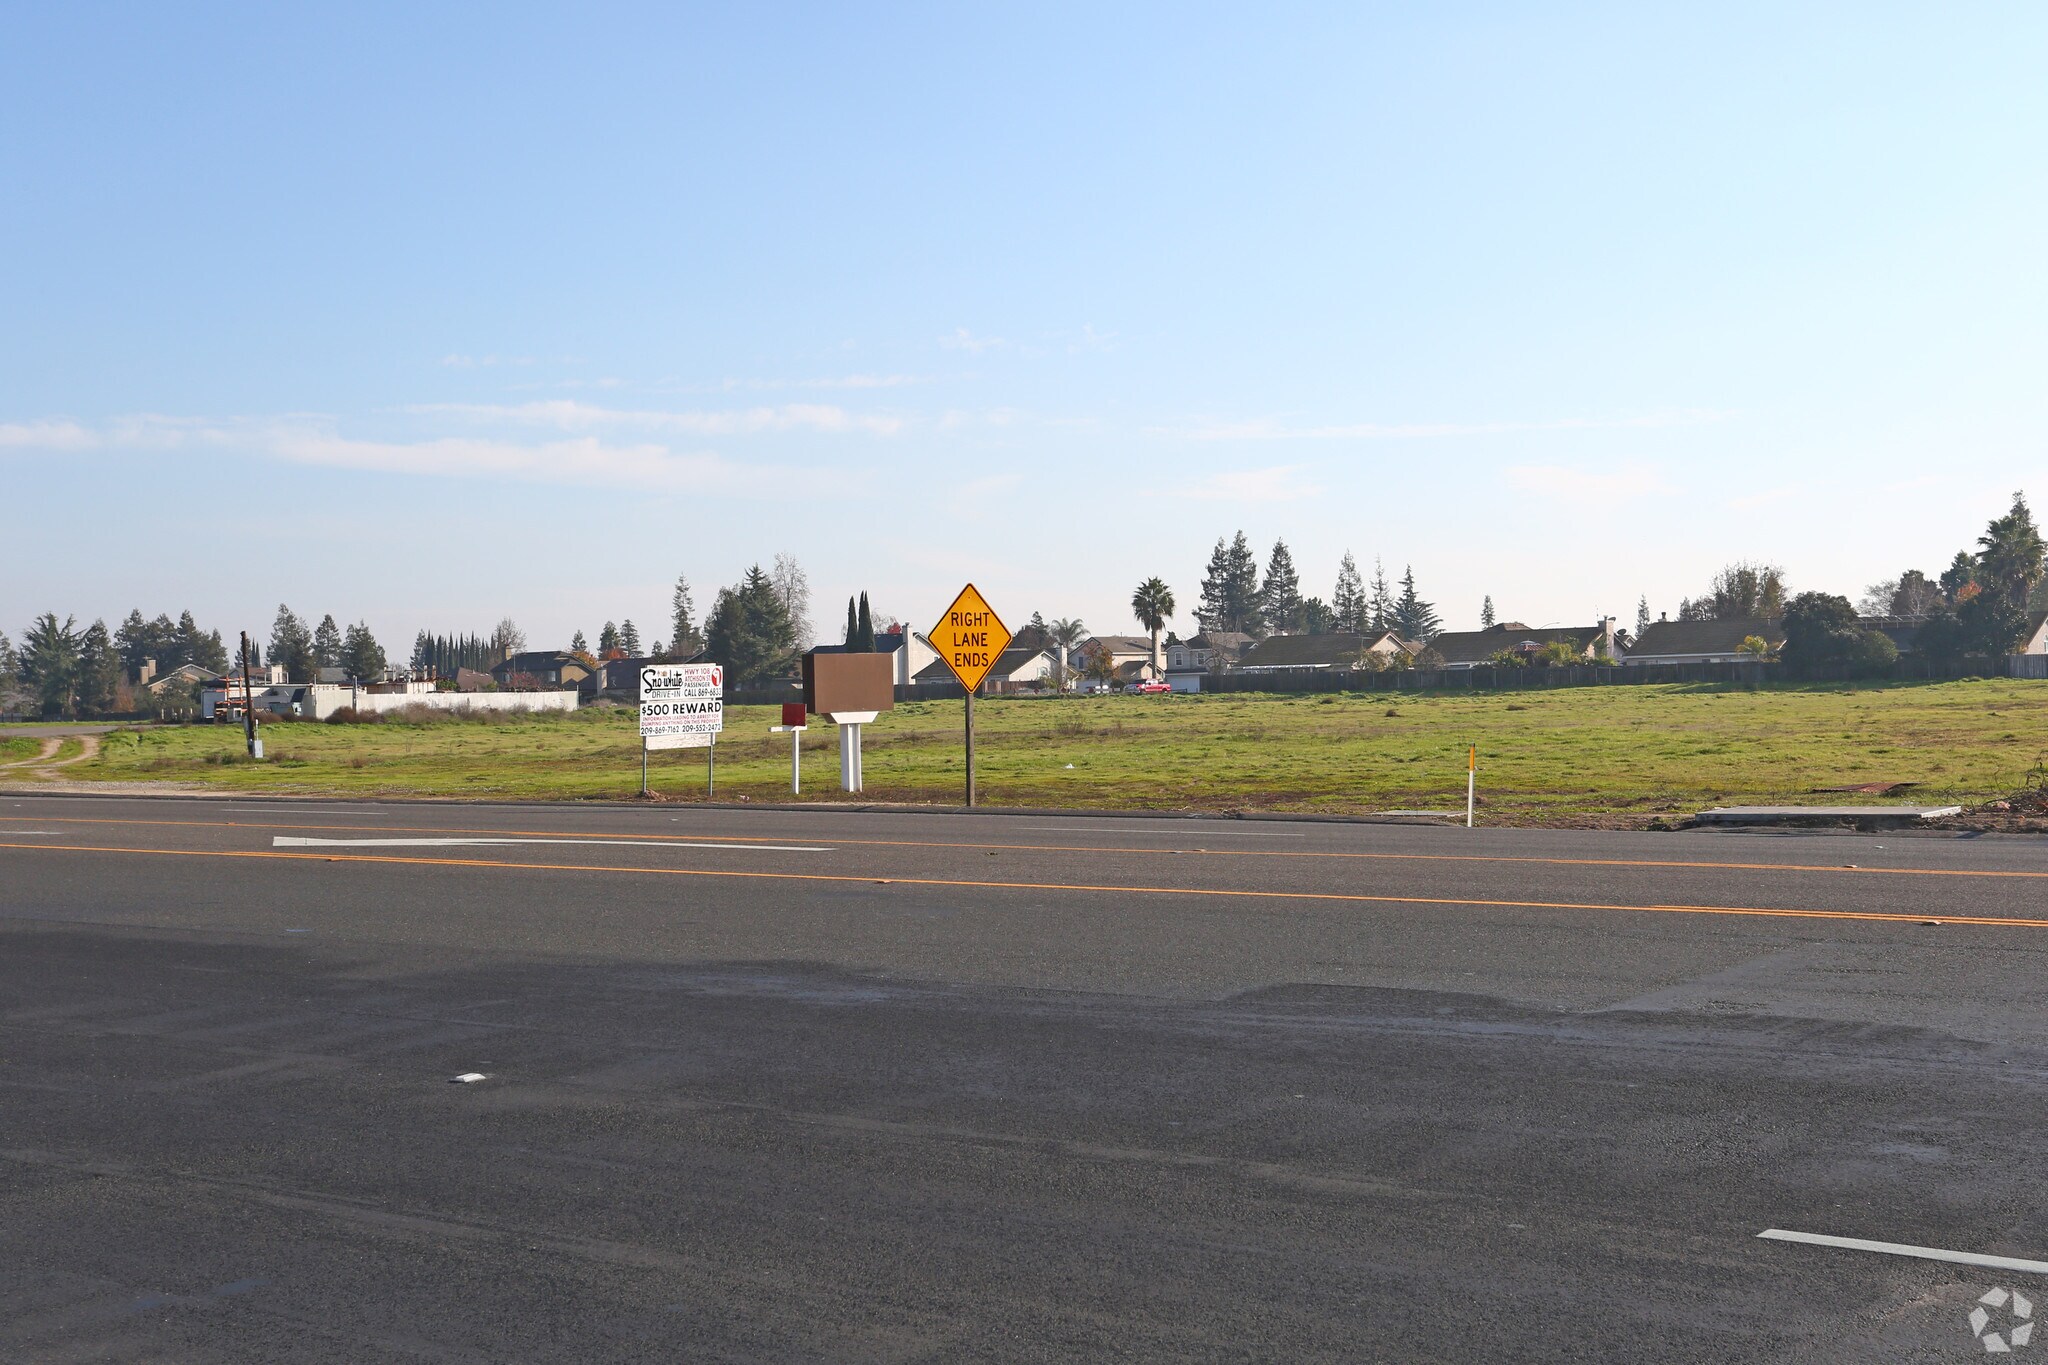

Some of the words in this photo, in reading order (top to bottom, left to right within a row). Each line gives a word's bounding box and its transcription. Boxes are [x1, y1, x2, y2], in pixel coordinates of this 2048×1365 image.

[951, 612, 990, 627] RIGHT
[953, 632, 988, 647] LANE
[954, 652, 989, 667] ENDS
[652, 690, 681, 698] DRIVE-IN
[684, 689, 697, 697] CALL
[641, 704, 669, 716] $500
[672, 702, 721, 714] REWARD
[641, 726, 679, 735] 209-869-7162
